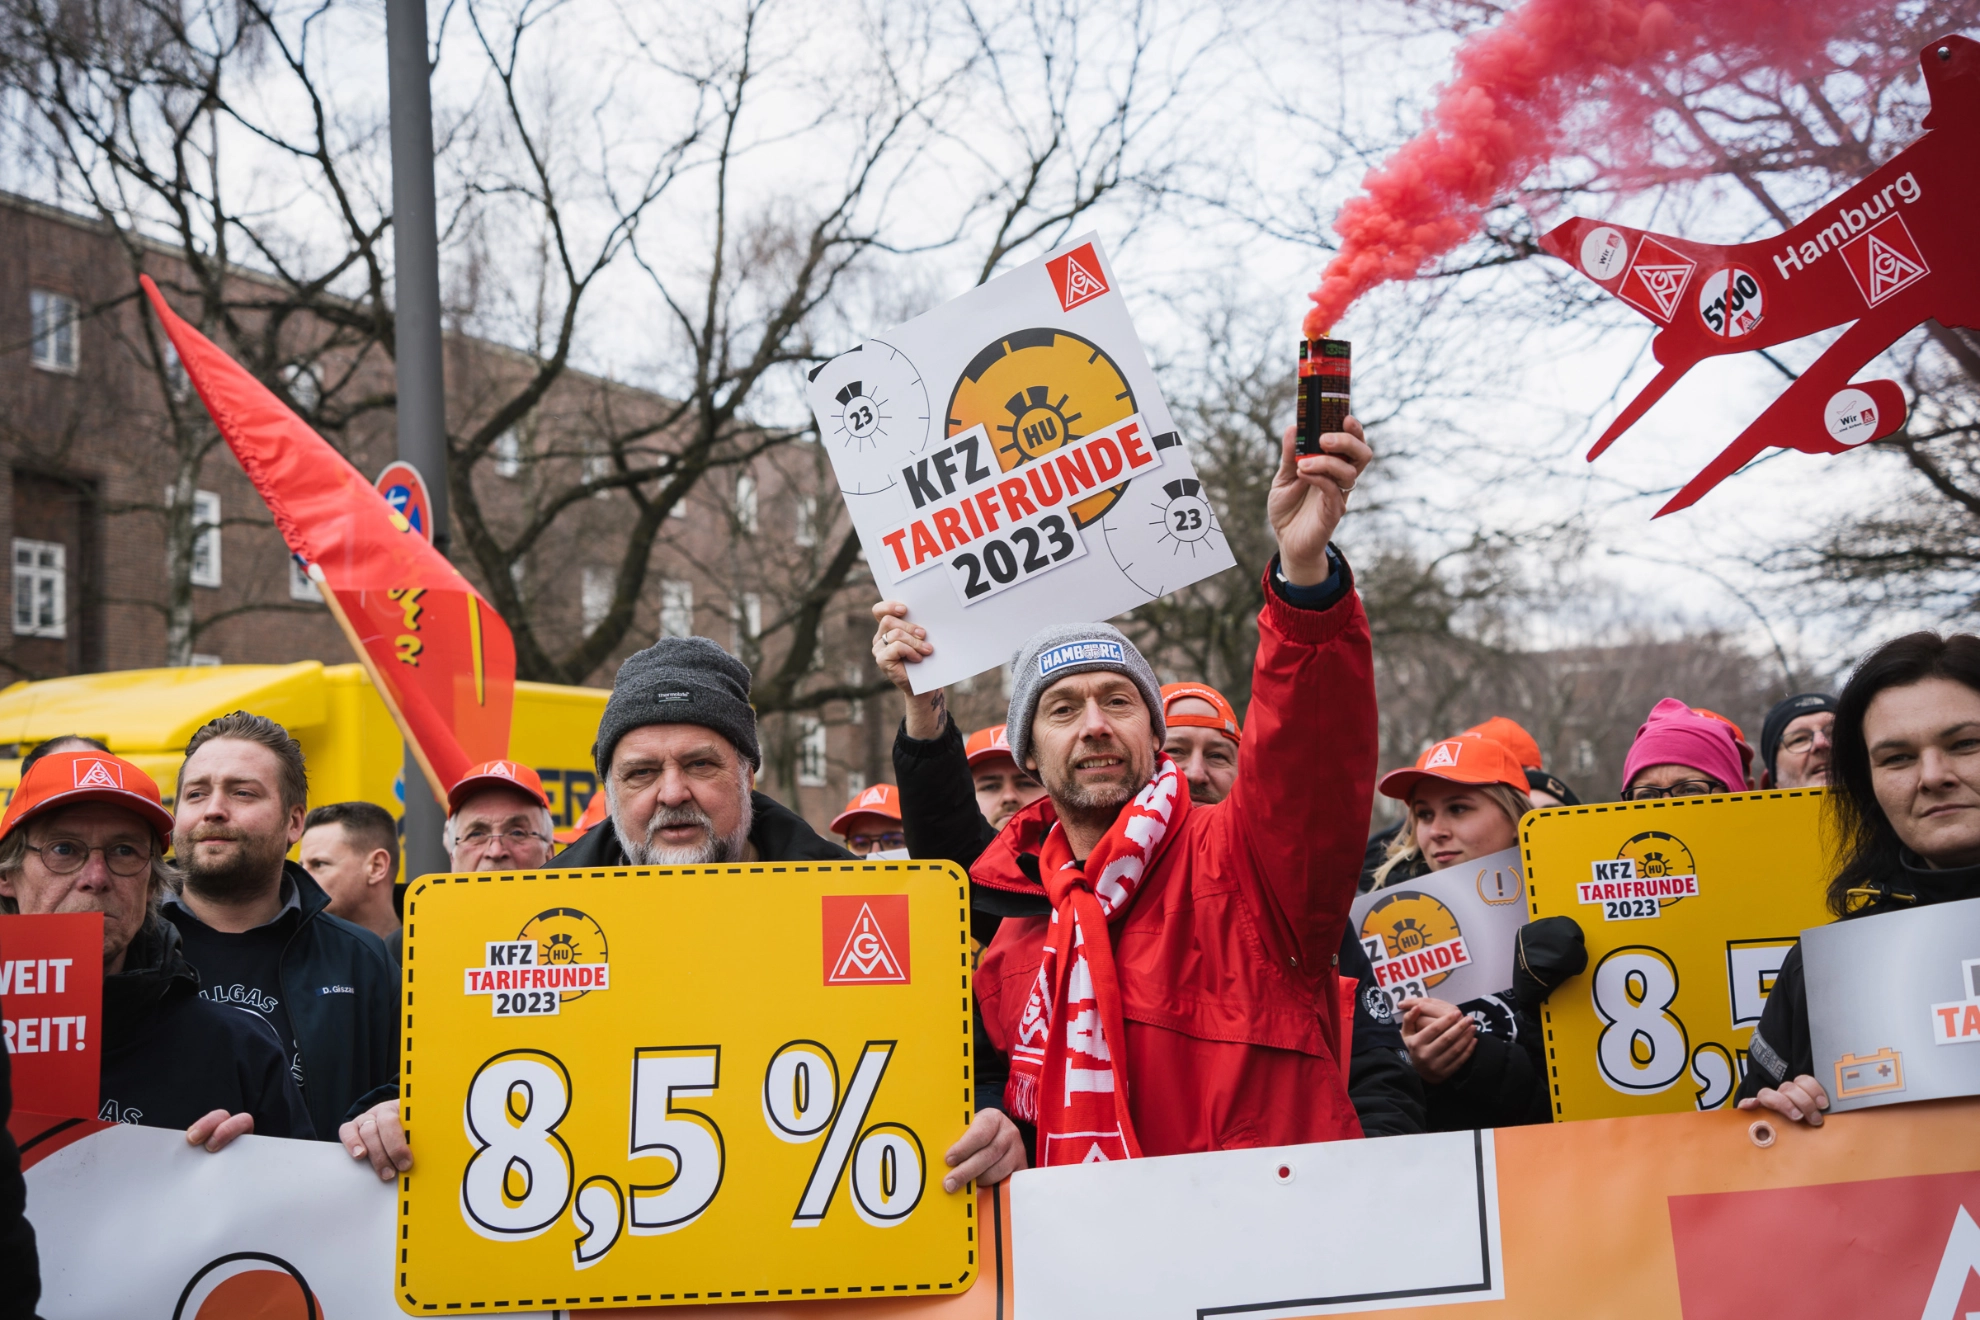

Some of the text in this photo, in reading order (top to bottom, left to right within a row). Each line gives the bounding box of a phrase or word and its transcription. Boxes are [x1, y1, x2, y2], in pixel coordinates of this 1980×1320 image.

[1773, 172, 1921, 280] Hamburg
[1599, 249, 1610, 265] Wir
[1702, 274, 1758, 332] 5100
[850, 406, 873, 430] 23
[1840, 415, 1857, 425] Wir
[1023, 416, 1057, 448] HU
[902, 435, 990, 509] KFZ
[882, 422, 1153, 573] TARIFRUNDE
[1173, 508, 1202, 531] 23
[952, 514, 1075, 600] 2023
[1596, 862, 1632, 880] KFZ
[1648, 865, 1662, 874] HU
[1580, 877, 1696, 901] TARIFRUNDE
[1606, 899, 1656, 919] 2023
[1401, 934, 1419, 948] HU
[490, 943, 532, 966] KFZ
[552, 949, 569, 961] HU
[1374, 941, 1467, 987] FRUNDE
[468, 966, 606, 991] TARIFRUNDE
[497, 992, 556, 1014] 2023
[460, 1040, 927, 1270] 8,5 %
